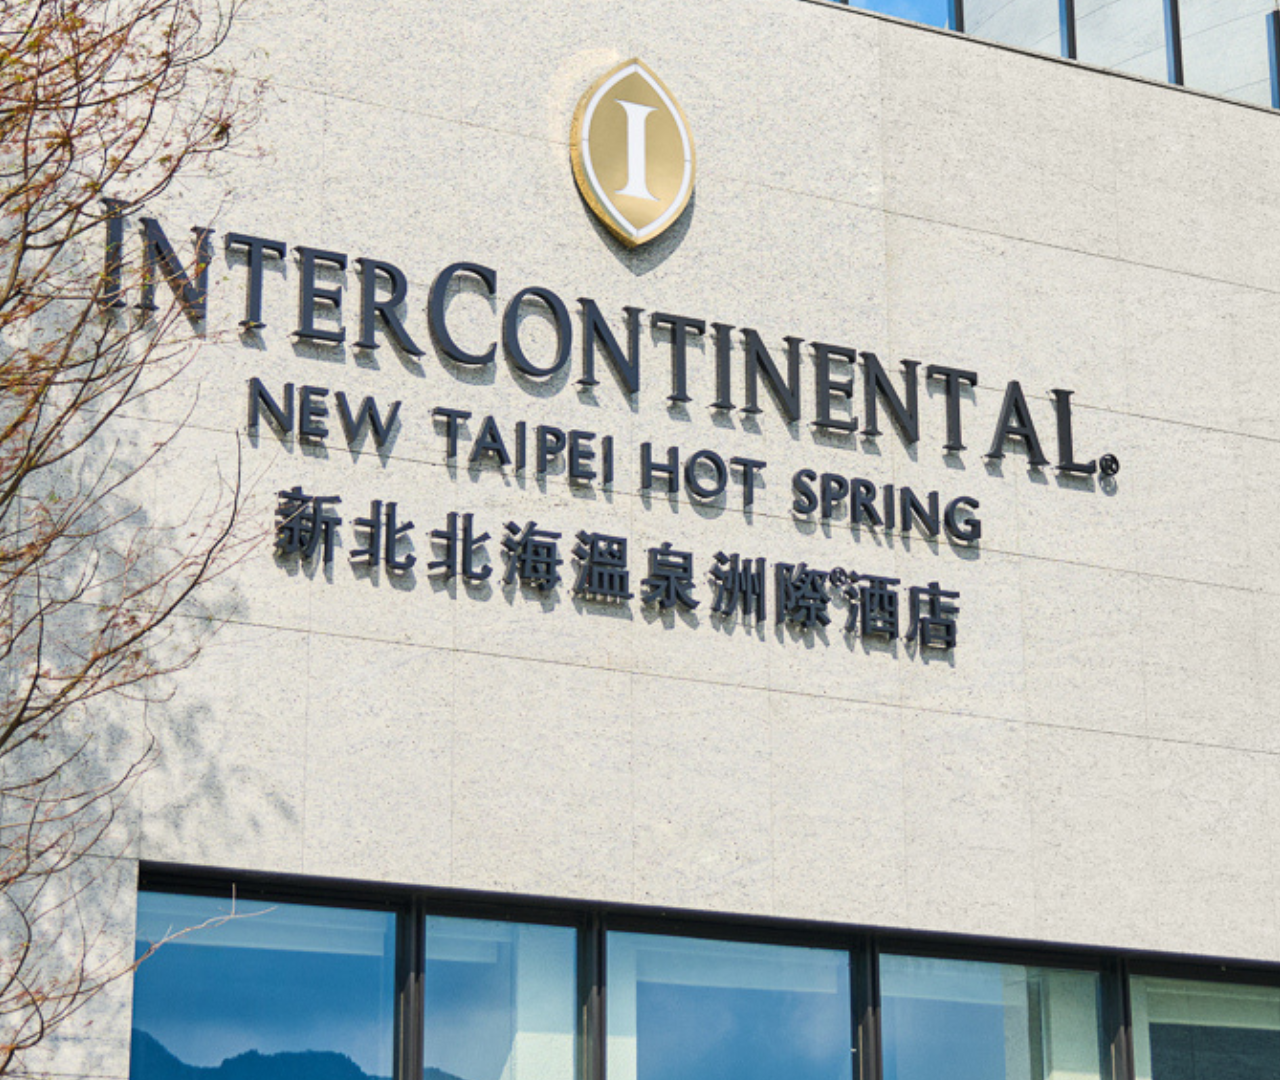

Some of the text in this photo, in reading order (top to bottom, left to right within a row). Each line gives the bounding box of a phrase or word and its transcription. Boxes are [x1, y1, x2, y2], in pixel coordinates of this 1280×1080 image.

[613, 98, 661, 202] I
[247, 377, 982, 543] NEW TAIPEI HOT SPRING
